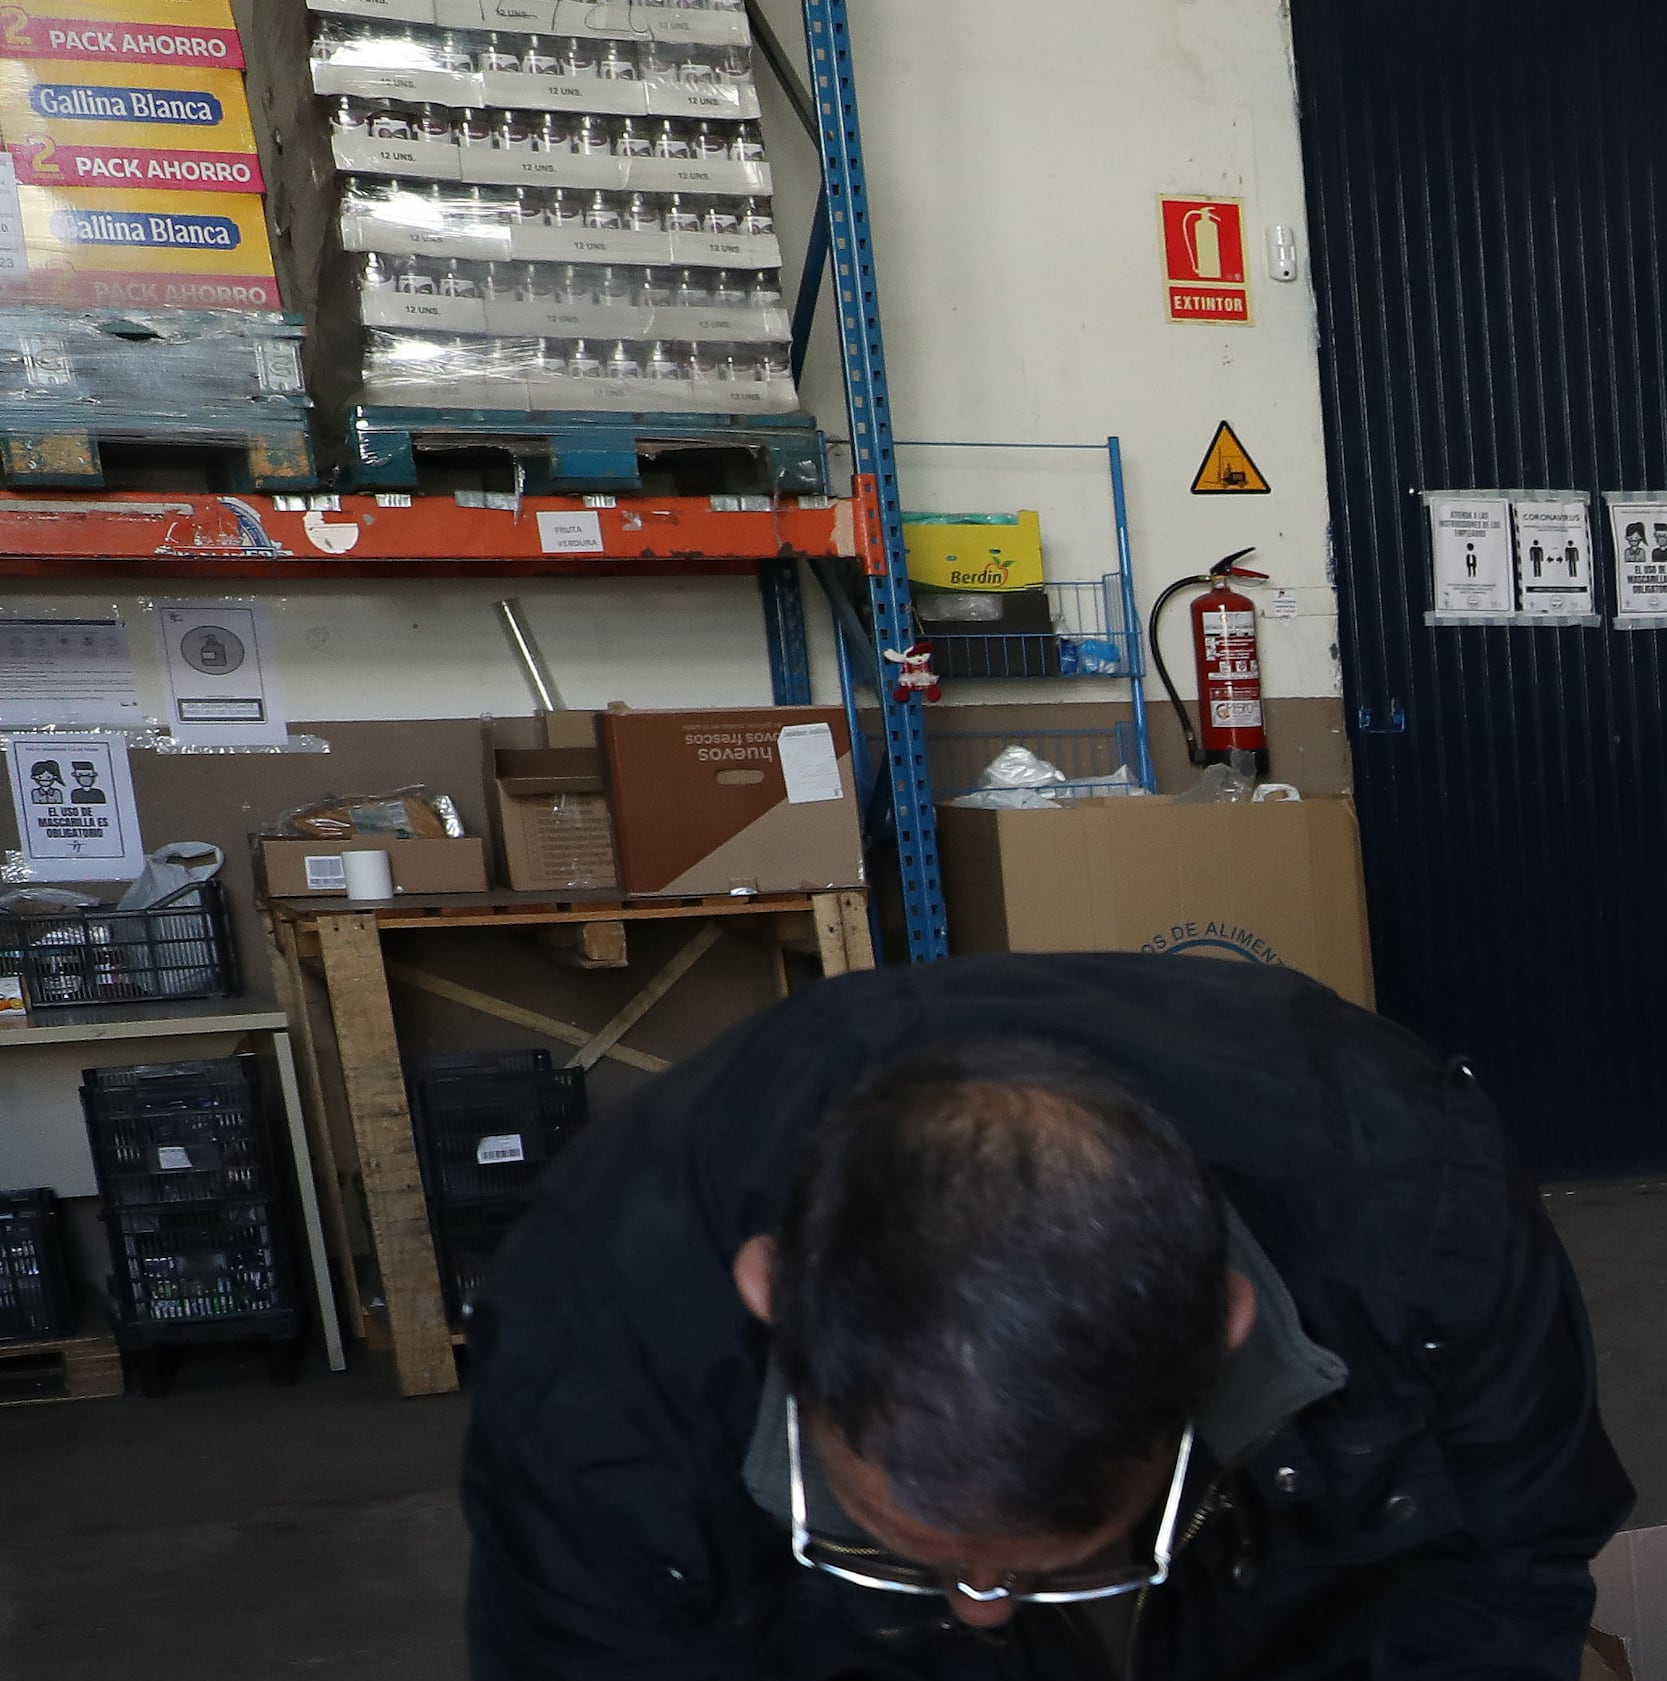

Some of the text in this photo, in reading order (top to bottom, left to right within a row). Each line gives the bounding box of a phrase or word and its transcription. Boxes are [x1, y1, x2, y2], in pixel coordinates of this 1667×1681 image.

[50, 29, 114, 52] PACK
[122, 33, 227, 57] AHORRO
[40, 89, 213, 121] Gallina Blanca
[688, 97, 698, 105] 12
[381, 151, 391, 159] 12
[75, 156, 143, 179] PACK
[147, 160, 251, 183] AHORRO
[149, 218, 231, 245] Blanca
[95, 282, 267, 304] PACK AHORRO
[1173, 296, 1243, 312] EXTINTOR
[1523, 513, 1581, 522] CORONAVIRUS
[951, 570, 1002, 584] Berdin
[1627, 575, 1667, 584] MASCARILLA
[685, 733, 743, 746] frescos
[698, 747, 773, 762] huevos
[48, 807, 93, 817] EL USO DE
[38, 817, 109, 827] MASCARILLA ES
[46, 828, 104, 838] OBLIGATORIO
[1171, 921, 1199, 941] DE
